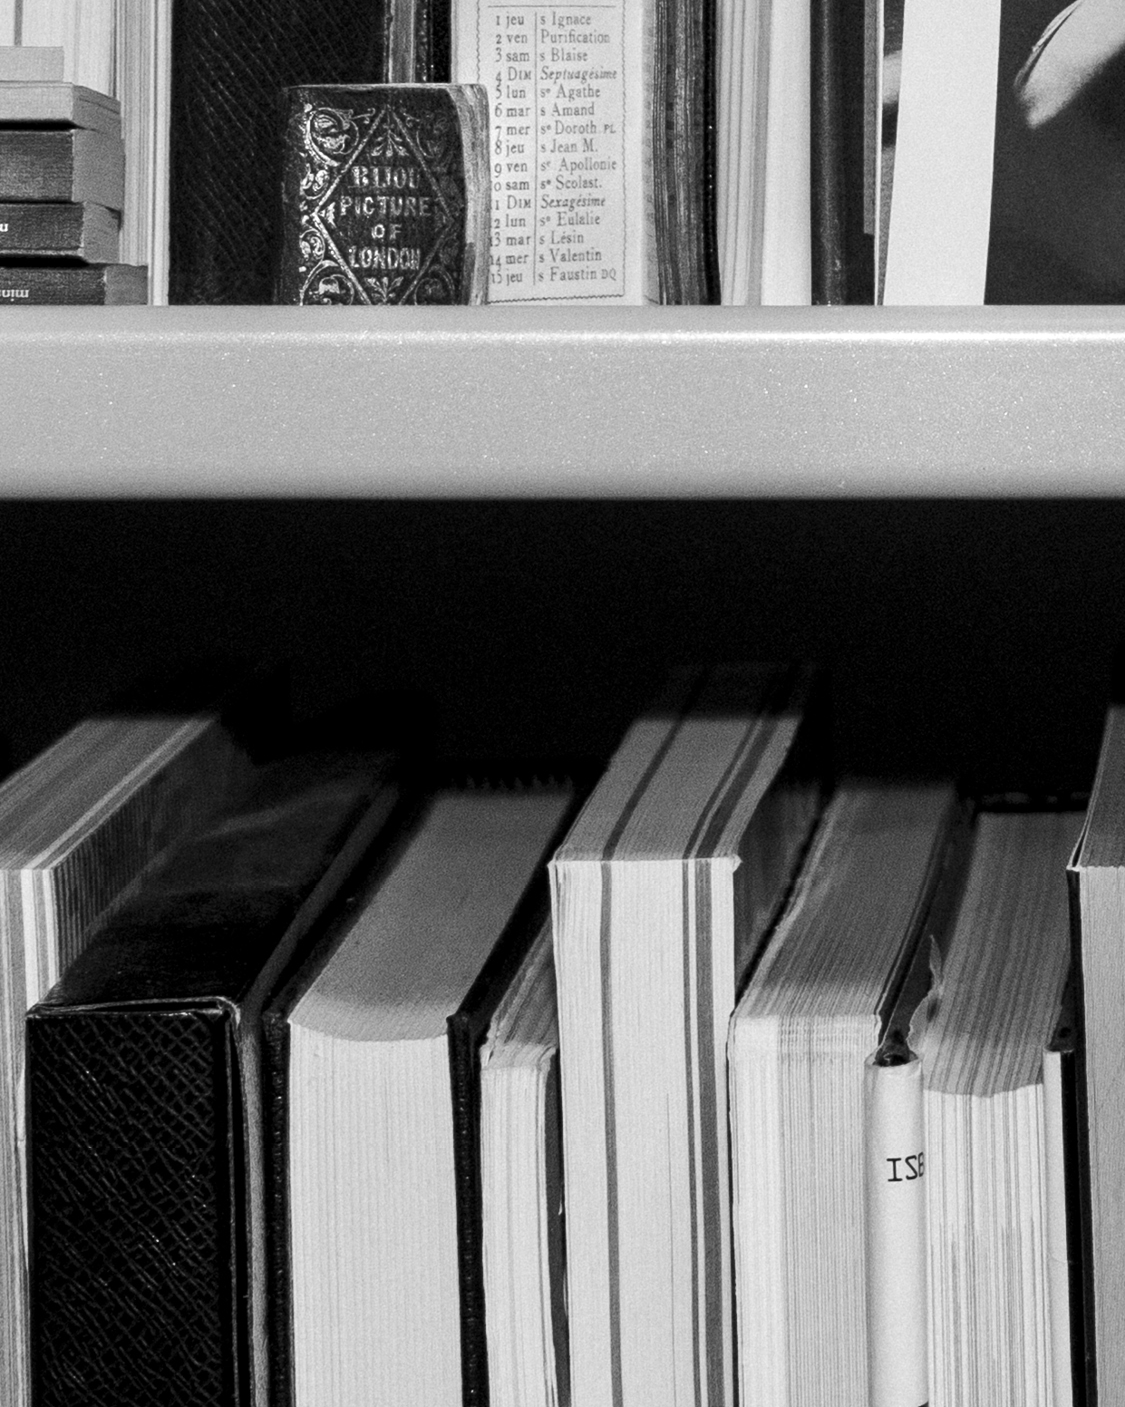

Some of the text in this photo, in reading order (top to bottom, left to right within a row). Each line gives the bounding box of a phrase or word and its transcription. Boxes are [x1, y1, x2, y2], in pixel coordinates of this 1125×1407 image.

[506, 11, 525, 29] jeu
[552, 11, 592, 29] Ignace
[495, 28, 611, 44] 2 ven Purification
[495, 47, 502, 62] 3
[506, 52, 530, 63] sam
[551, 47, 588, 62] Blaise
[495, 85, 502, 99] 5
[506, 84, 526, 99] lun
[556, 83, 601, 102] Agathe
[494, 102, 503, 117] 6
[506, 107, 531, 117] mar
[551, 101, 595, 116] Amand
[494, 125, 502, 141] 7
[506, 125, 531, 135] mer
[494, 140, 502, 155] 8
[506, 139, 525, 157] jeu
[550, 138, 578, 153] Jean
[494, 163, 502, 178] 9
[506, 162, 528, 172] ven
[558, 156, 617, 175] Apollonie
[352, 165, 421, 189] BIJOU
[505, 180, 530, 191] sam
[340, 196, 432, 216] PICTURE
[541, 193, 606, 212] Sexagésime
[505, 213, 526, 227] lun
[556, 211, 601, 226] Eulalie
[371, 223, 402, 239] OF
[506, 235, 531, 246] mar
[551, 229, 585, 245] Lésin
[348, 246, 421, 270] LONDON
[505, 254, 529, 265] mer
[549, 247, 602, 263] Valentin
[506, 268, 523, 286] jeu
[550, 266, 597, 281] Faustin
